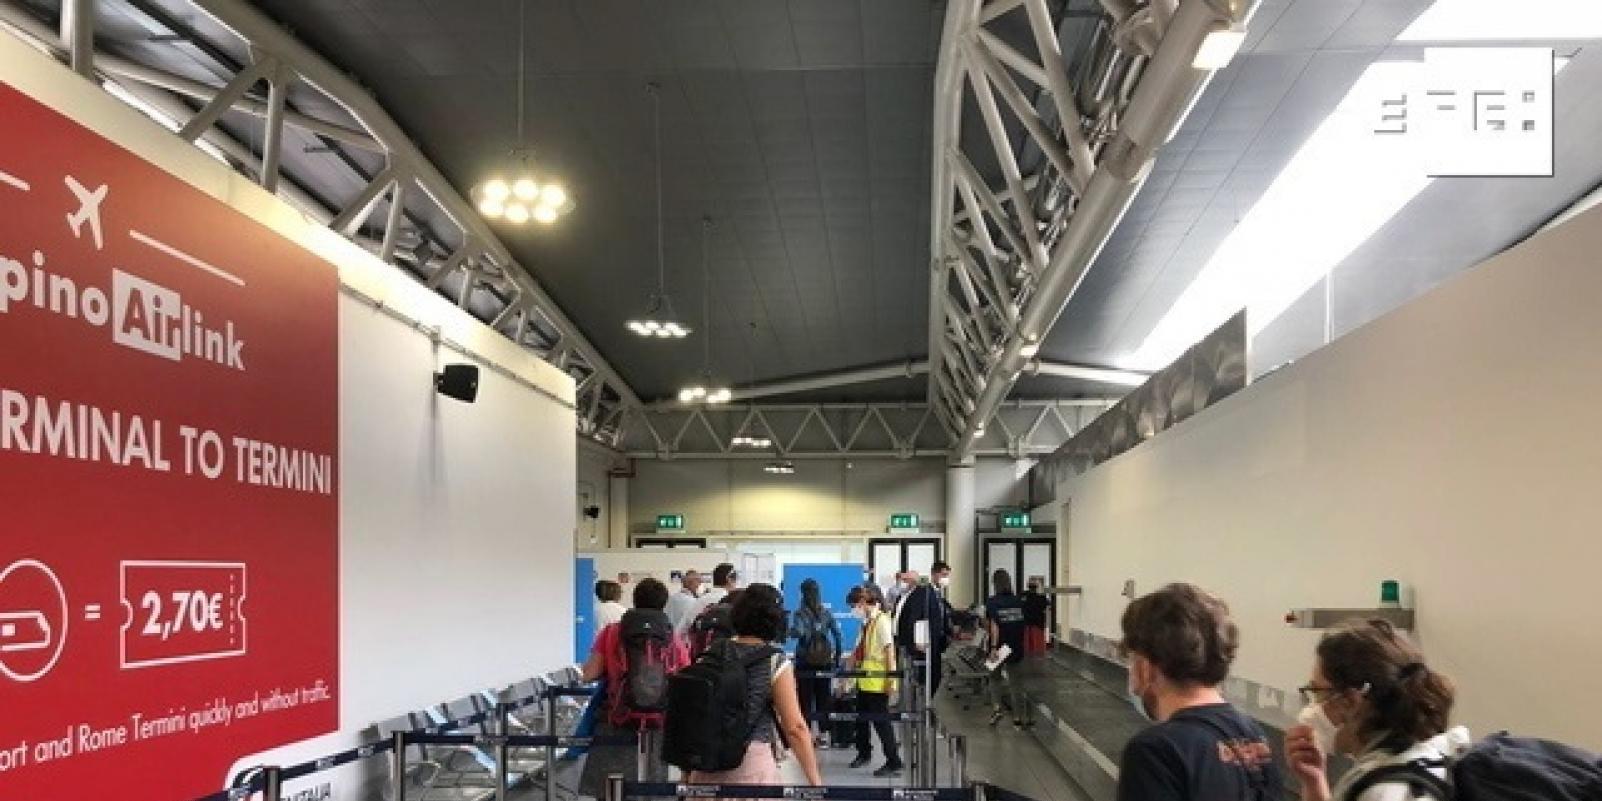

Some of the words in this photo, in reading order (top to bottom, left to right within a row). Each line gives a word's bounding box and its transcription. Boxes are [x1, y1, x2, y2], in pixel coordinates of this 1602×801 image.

[1, 389, 171, 471] RMINAL
[179, 425, 224, 479] TO
[232, 437, 331, 495] TERMINI
[140, 590, 224, 641] 2,70€
[0, 740, 28, 771] ort
[34, 725, 73, 763] and
[78, 722, 128, 754] Rome
[132, 706, 186, 741] Termini
[189, 697, 233, 734] quickly
[235, 690, 259, 719] and
[262, 687, 299, 711] without
